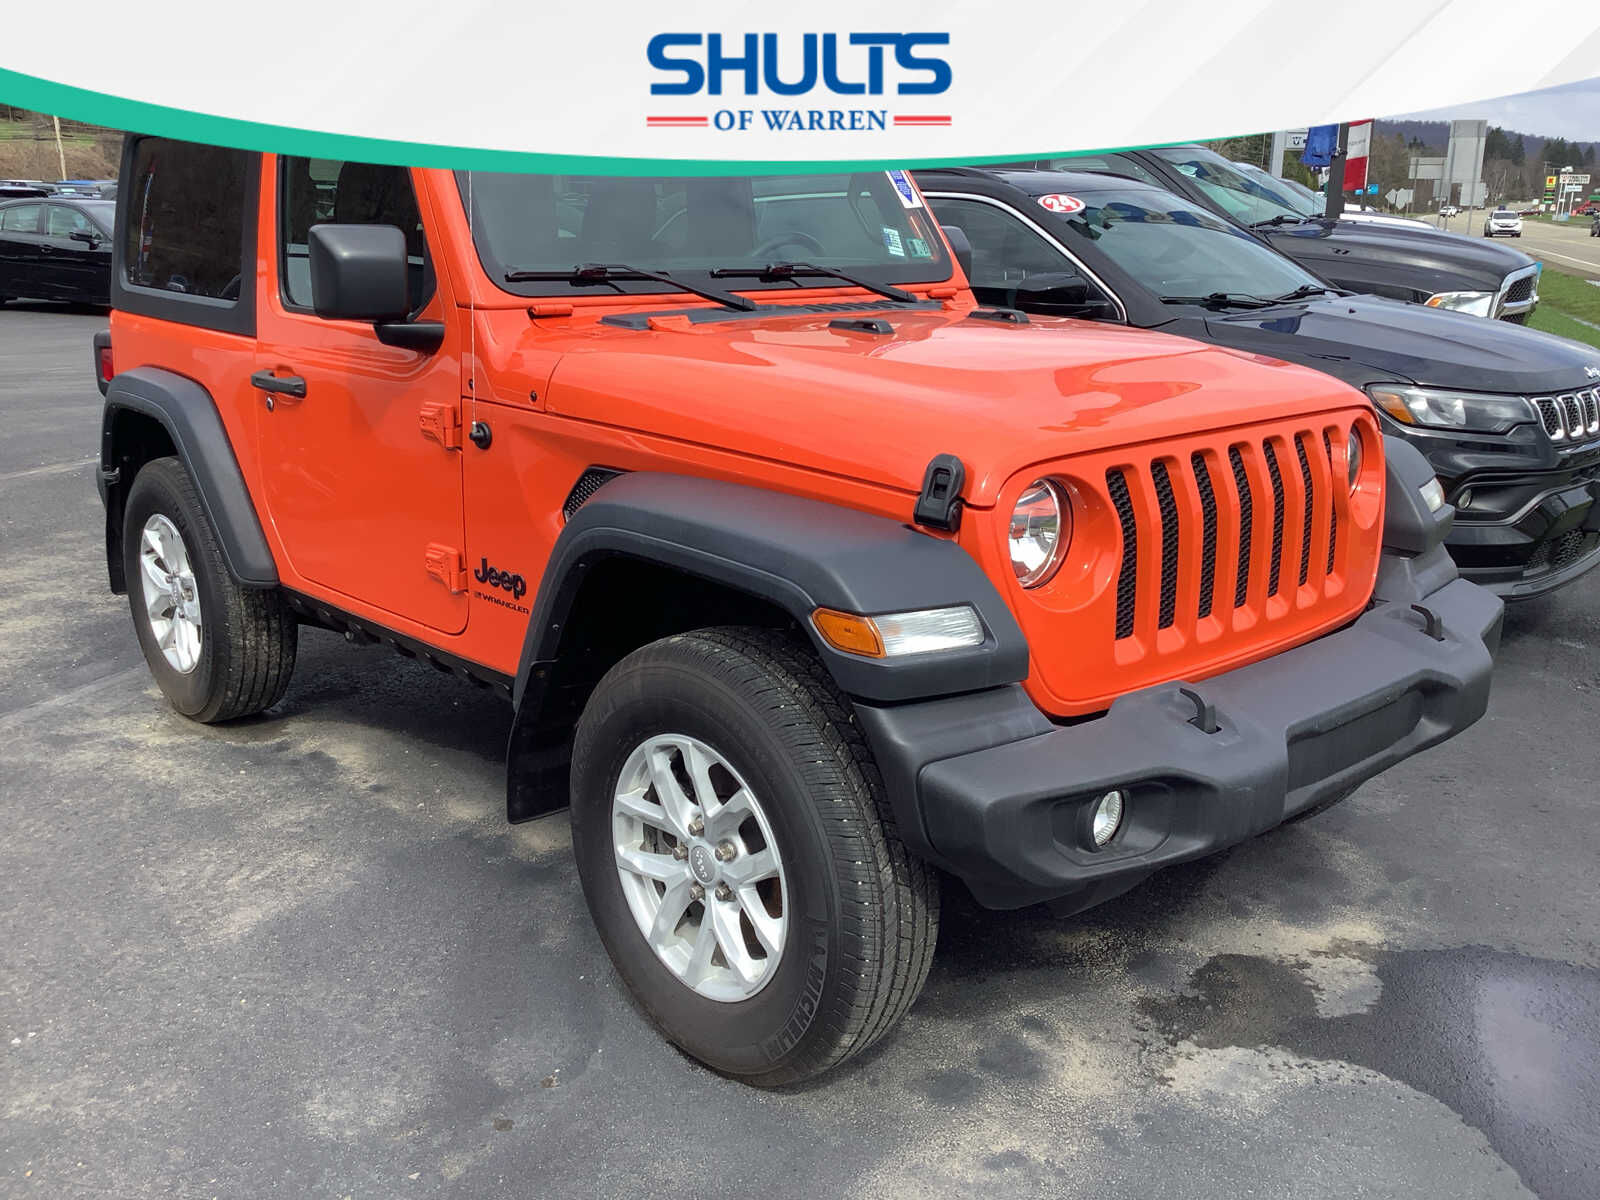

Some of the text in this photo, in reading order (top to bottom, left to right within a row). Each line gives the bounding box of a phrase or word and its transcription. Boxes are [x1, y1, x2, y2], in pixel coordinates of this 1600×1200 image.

[1046, 195, 1078, 212] 24
[474, 557, 527, 601] Jeep
[481, 592, 529, 615] WRANGLER
